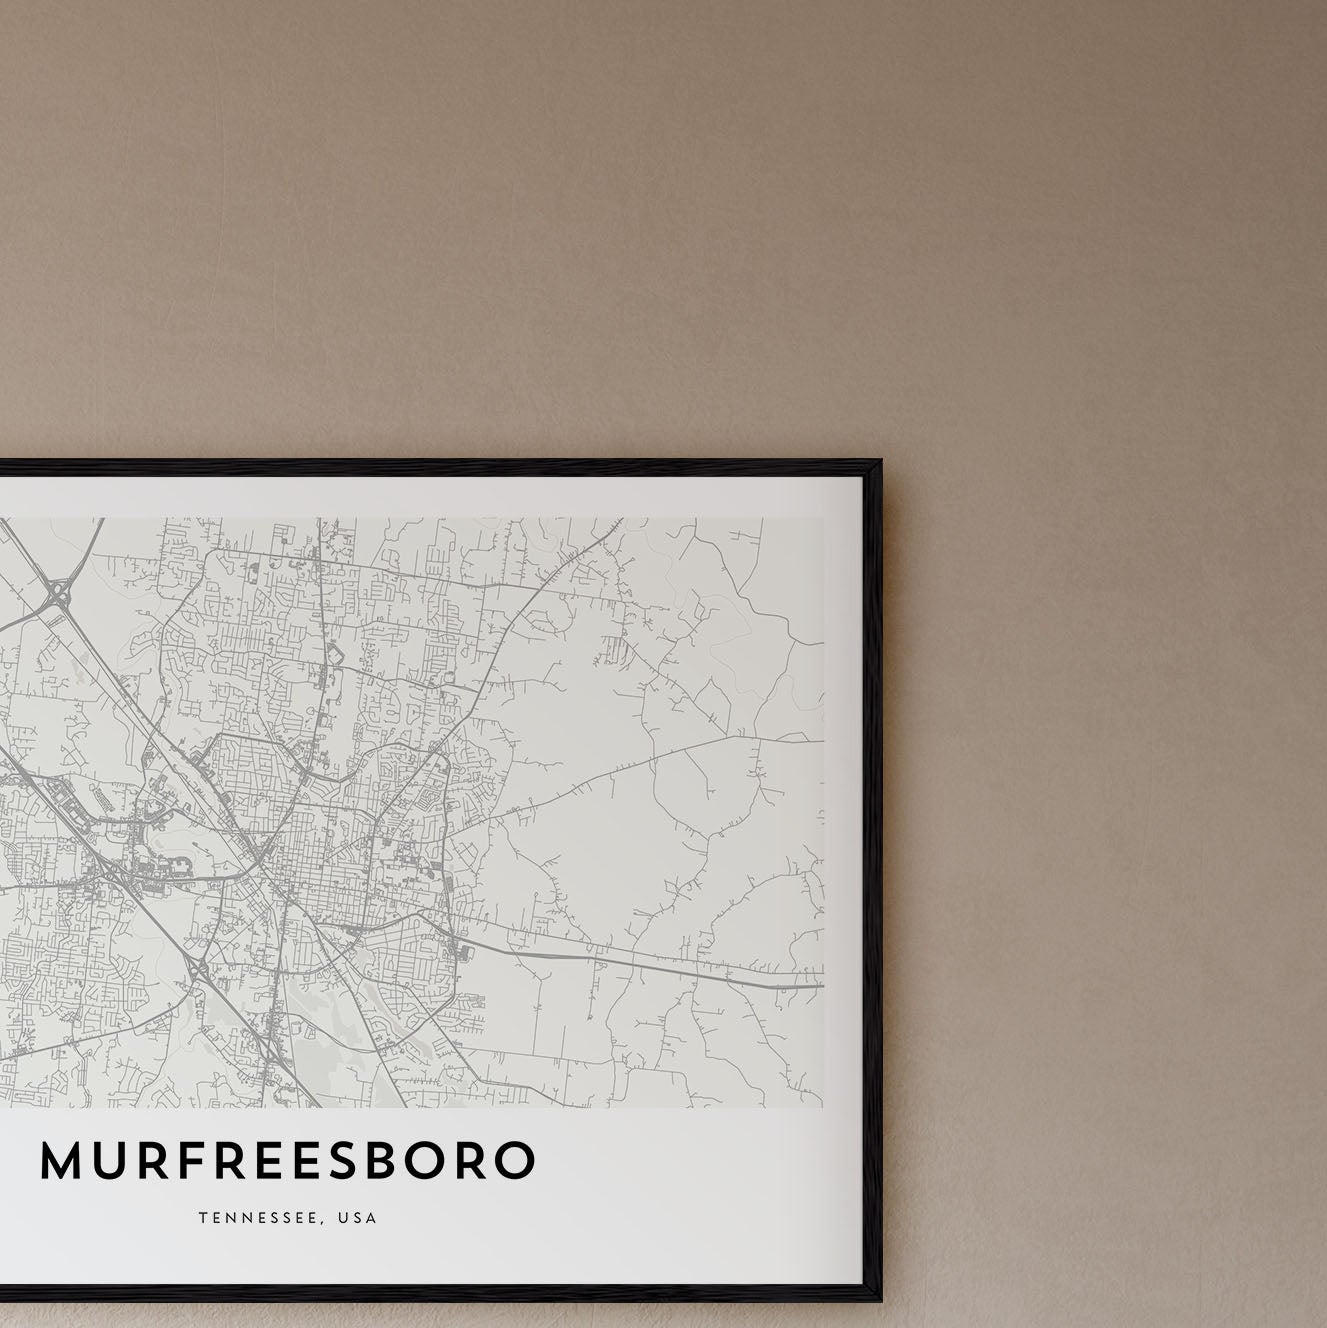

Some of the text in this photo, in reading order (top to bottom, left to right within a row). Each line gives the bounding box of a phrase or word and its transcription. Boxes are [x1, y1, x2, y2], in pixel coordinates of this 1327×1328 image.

[41, 1140, 535, 1180] MURFREESBORO
[198, 1211, 376, 1226] TENNESSEE, USA
